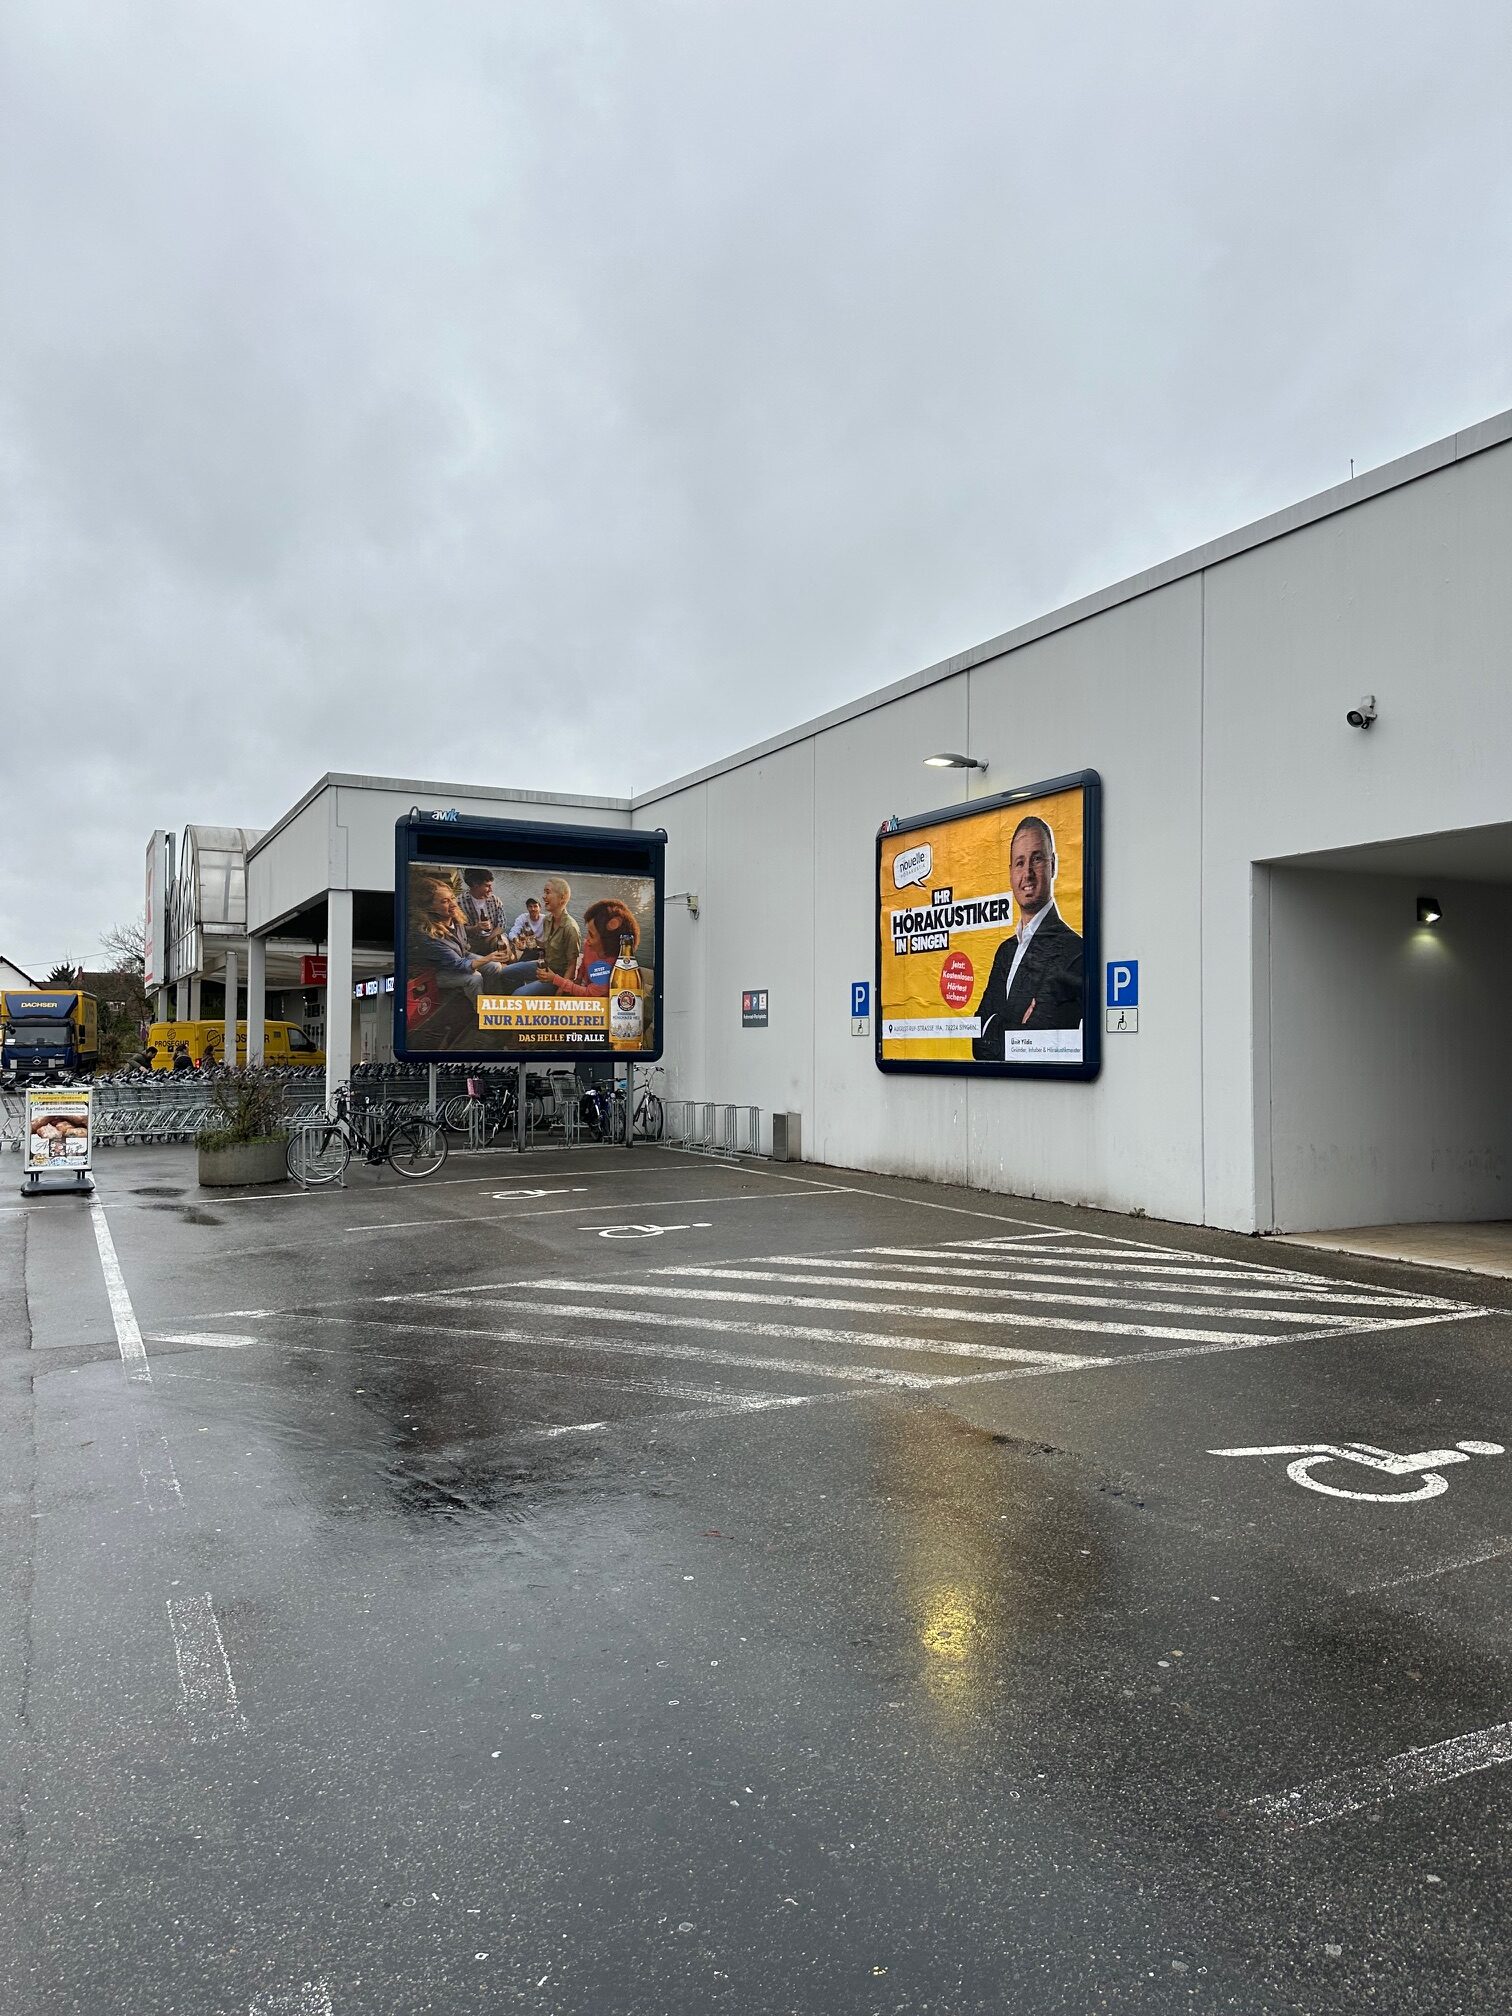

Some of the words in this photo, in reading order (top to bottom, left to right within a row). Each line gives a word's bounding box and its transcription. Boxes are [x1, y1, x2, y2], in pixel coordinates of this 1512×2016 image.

[934, 889, 951, 904] IHR
[893, 898, 1010, 935] HÖRAKUSTIKER
[896, 938, 907, 953] IN
[911, 933, 948, 951] SINGEN
[1113, 966, 1131, 1002] P
[481, 999, 523, 1010] ALLES
[524, 1000, 552, 1011] WIE
[554, 1000, 605, 1013] IMMER,
[855, 986, 866, 1013] P
[483, 1014, 512, 1026] NUR
[515, 1015, 605, 1026] ALKOHOLFREI
[518, 1033, 535, 1042] DAS
[537, 1034, 565, 1042] HELLE
[566, 1032, 583, 1042] FÜR
[584, 1034, 605, 1042] ALLE
